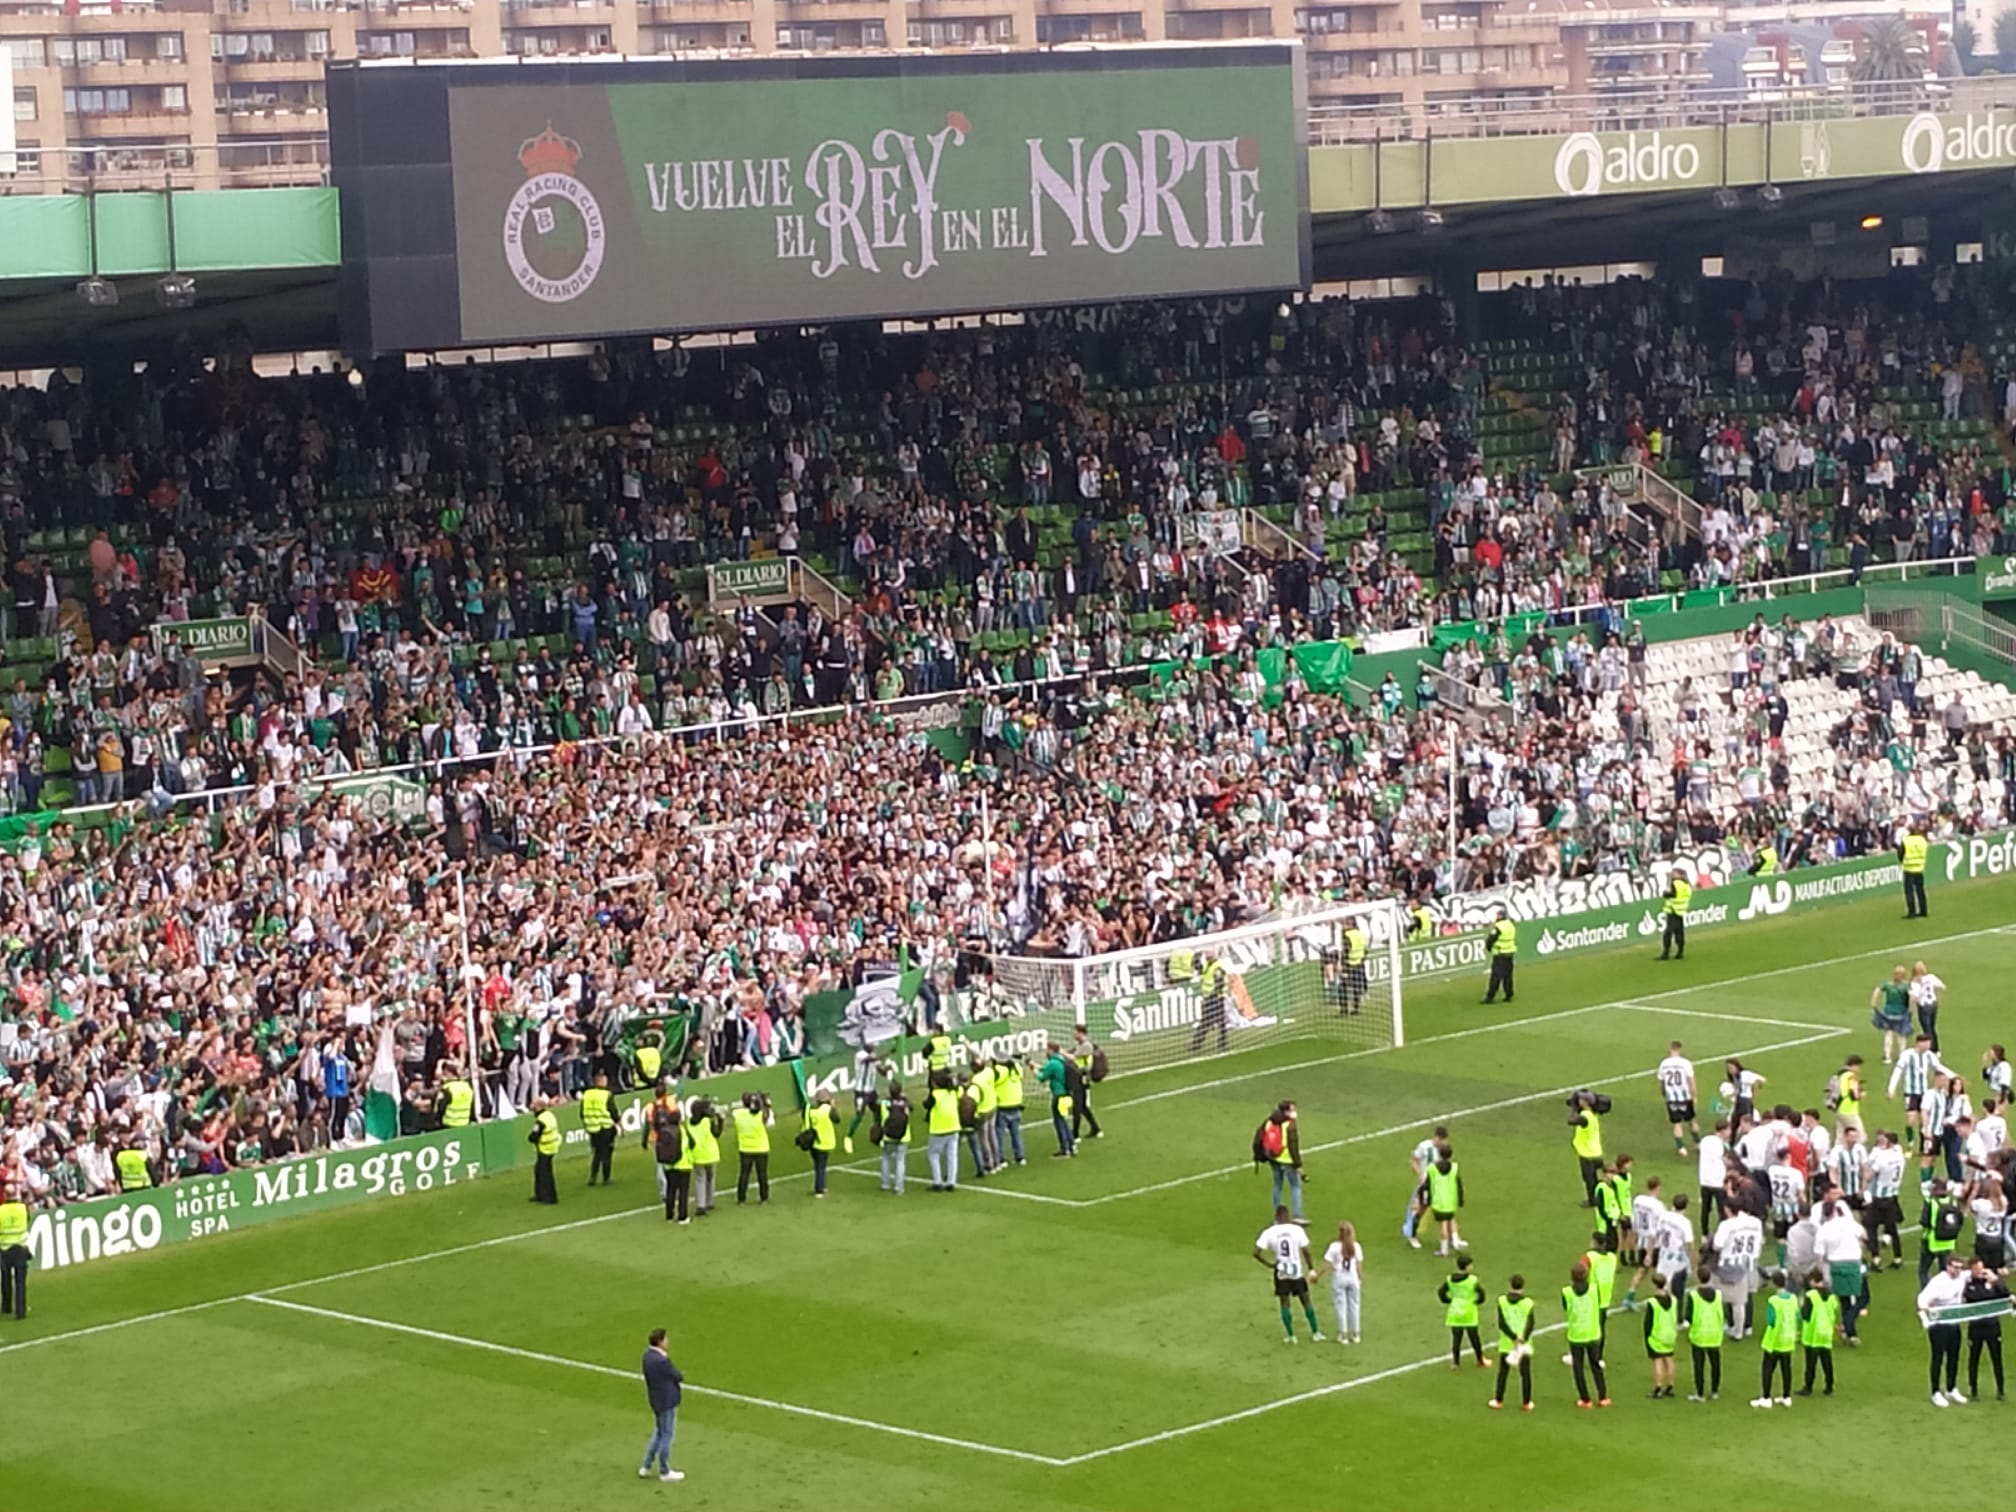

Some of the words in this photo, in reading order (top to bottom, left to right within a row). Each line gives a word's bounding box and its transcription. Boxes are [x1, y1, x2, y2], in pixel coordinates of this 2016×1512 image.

[1605, 131, 1699, 182] aldro
[644, 157, 794, 211] VUELVE
[507, 201, 526, 244] REAL
[524, 177, 578, 199] RACING
[579, 195, 601, 239] CLUB
[774, 214, 816, 259] EL
[804, 125, 965, 279] REY
[942, 208, 981, 251] EN
[991, 207, 1029, 249] EL
[1025, 129, 1263, 257] NORTE
[519, 263, 594, 298] SANTANDER
[735, 563, 785, 585] DIARIO
[188, 624, 247, 645] DIARIO
[1796, 871, 1863, 902] MANUFACTURAS
[1656, 902, 1728, 932] Stander
[1556, 921, 1630, 950] Santander
[1411, 939, 1487, 974] PASTOR
[1666, 1069, 1682, 1087] 20
[252, 1138, 462, 1207] Milagros
[389, 1161, 480, 1196] GOLF
[175, 1190, 240, 1218] HOTEL
[1772, 1180, 1790, 1199] 22
[191, 1214, 229, 1237] SPA
[1280, 1240, 1290, 1258] 9
